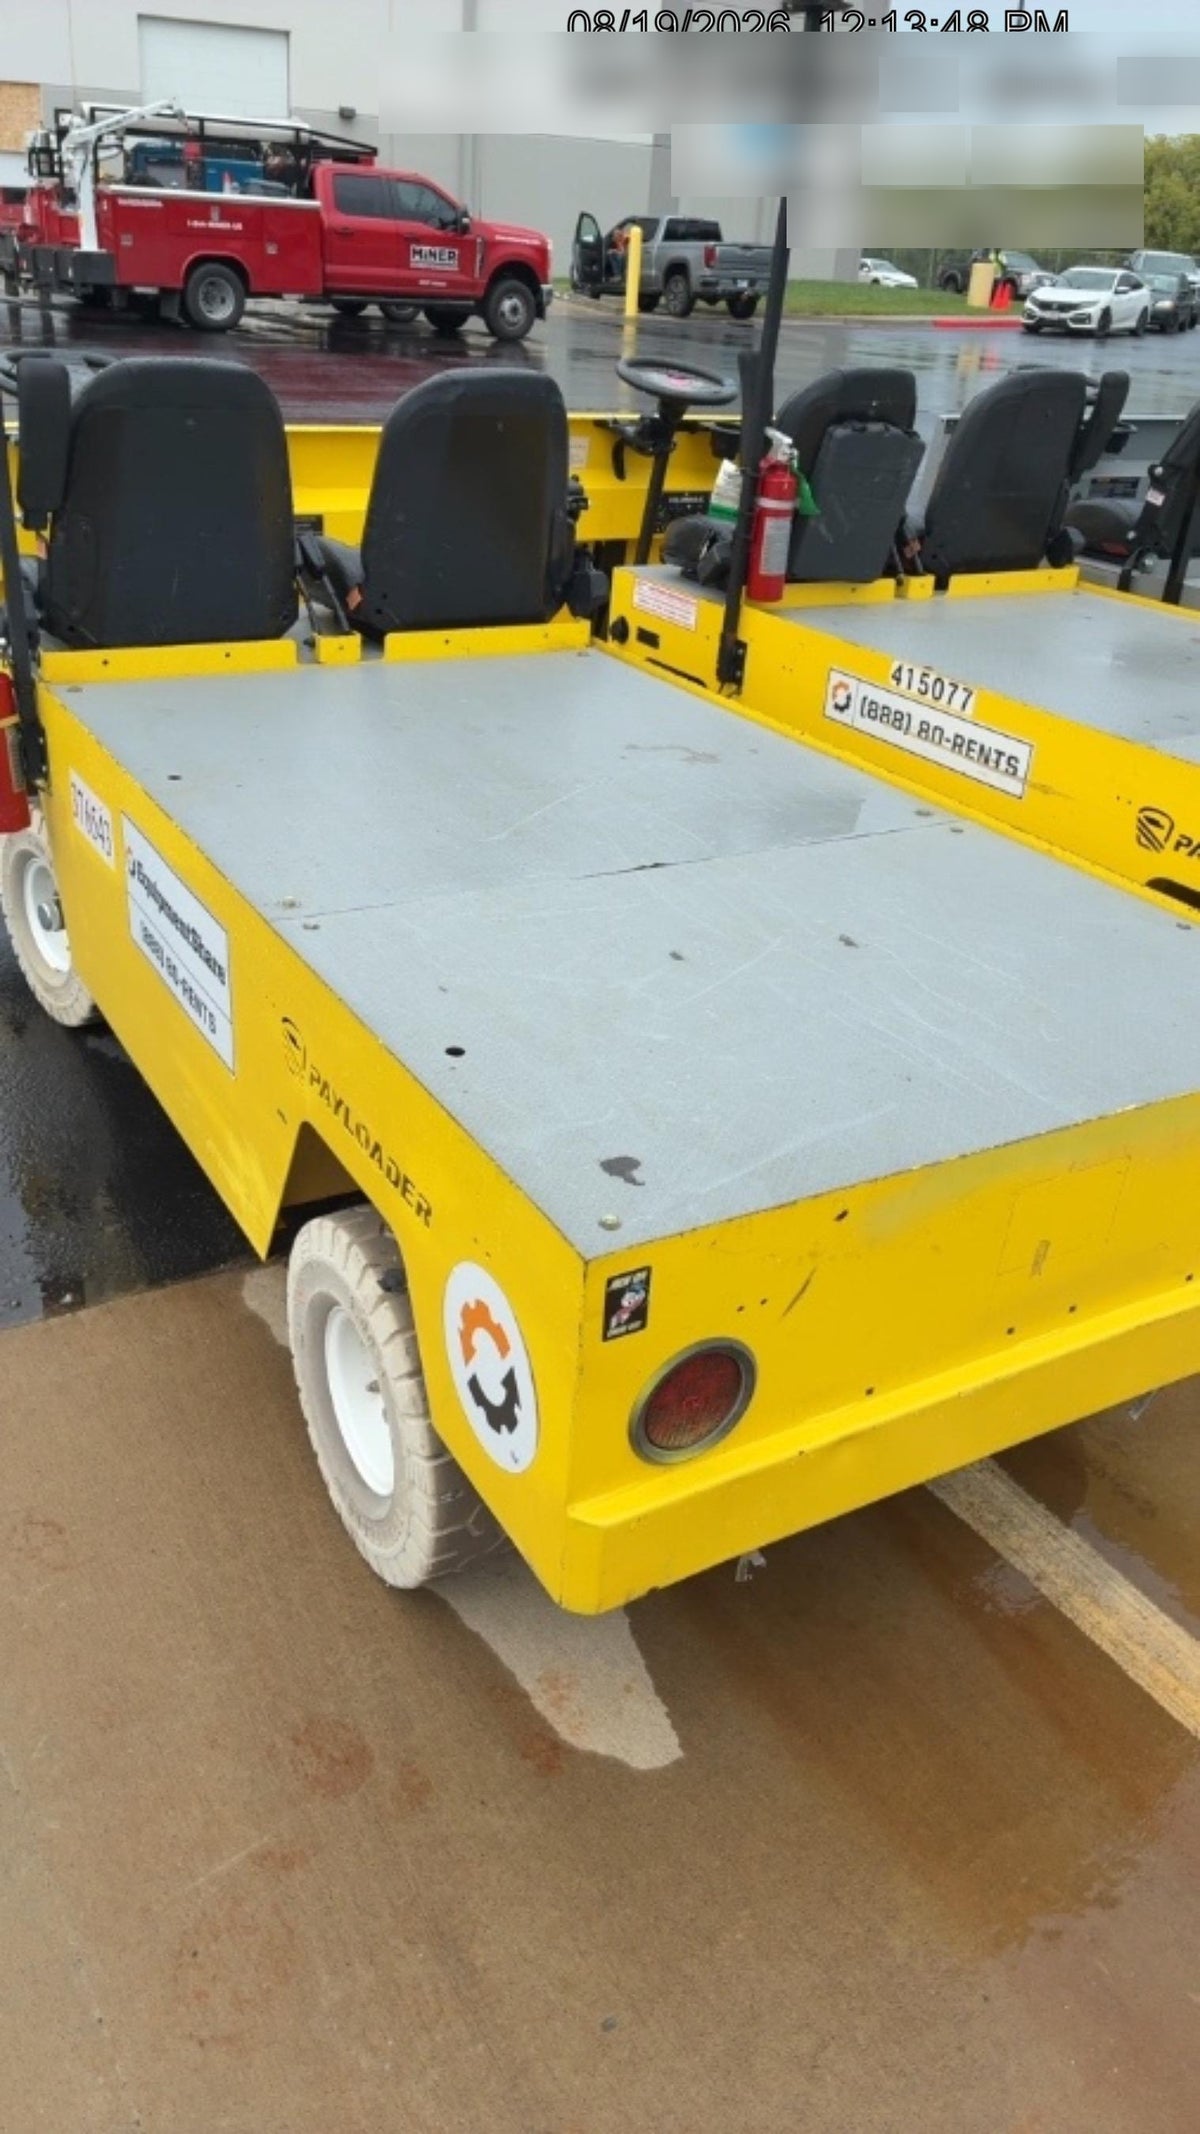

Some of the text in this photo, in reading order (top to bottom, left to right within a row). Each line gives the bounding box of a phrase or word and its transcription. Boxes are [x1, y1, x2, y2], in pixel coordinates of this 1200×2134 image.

[860, 695, 1020, 777] (888) 80-RENTS
[891, 664, 973, 712] 415077
[136, 860, 226, 986] EquipmentShare
[309, 1064, 432, 1228] PAYLOADER
